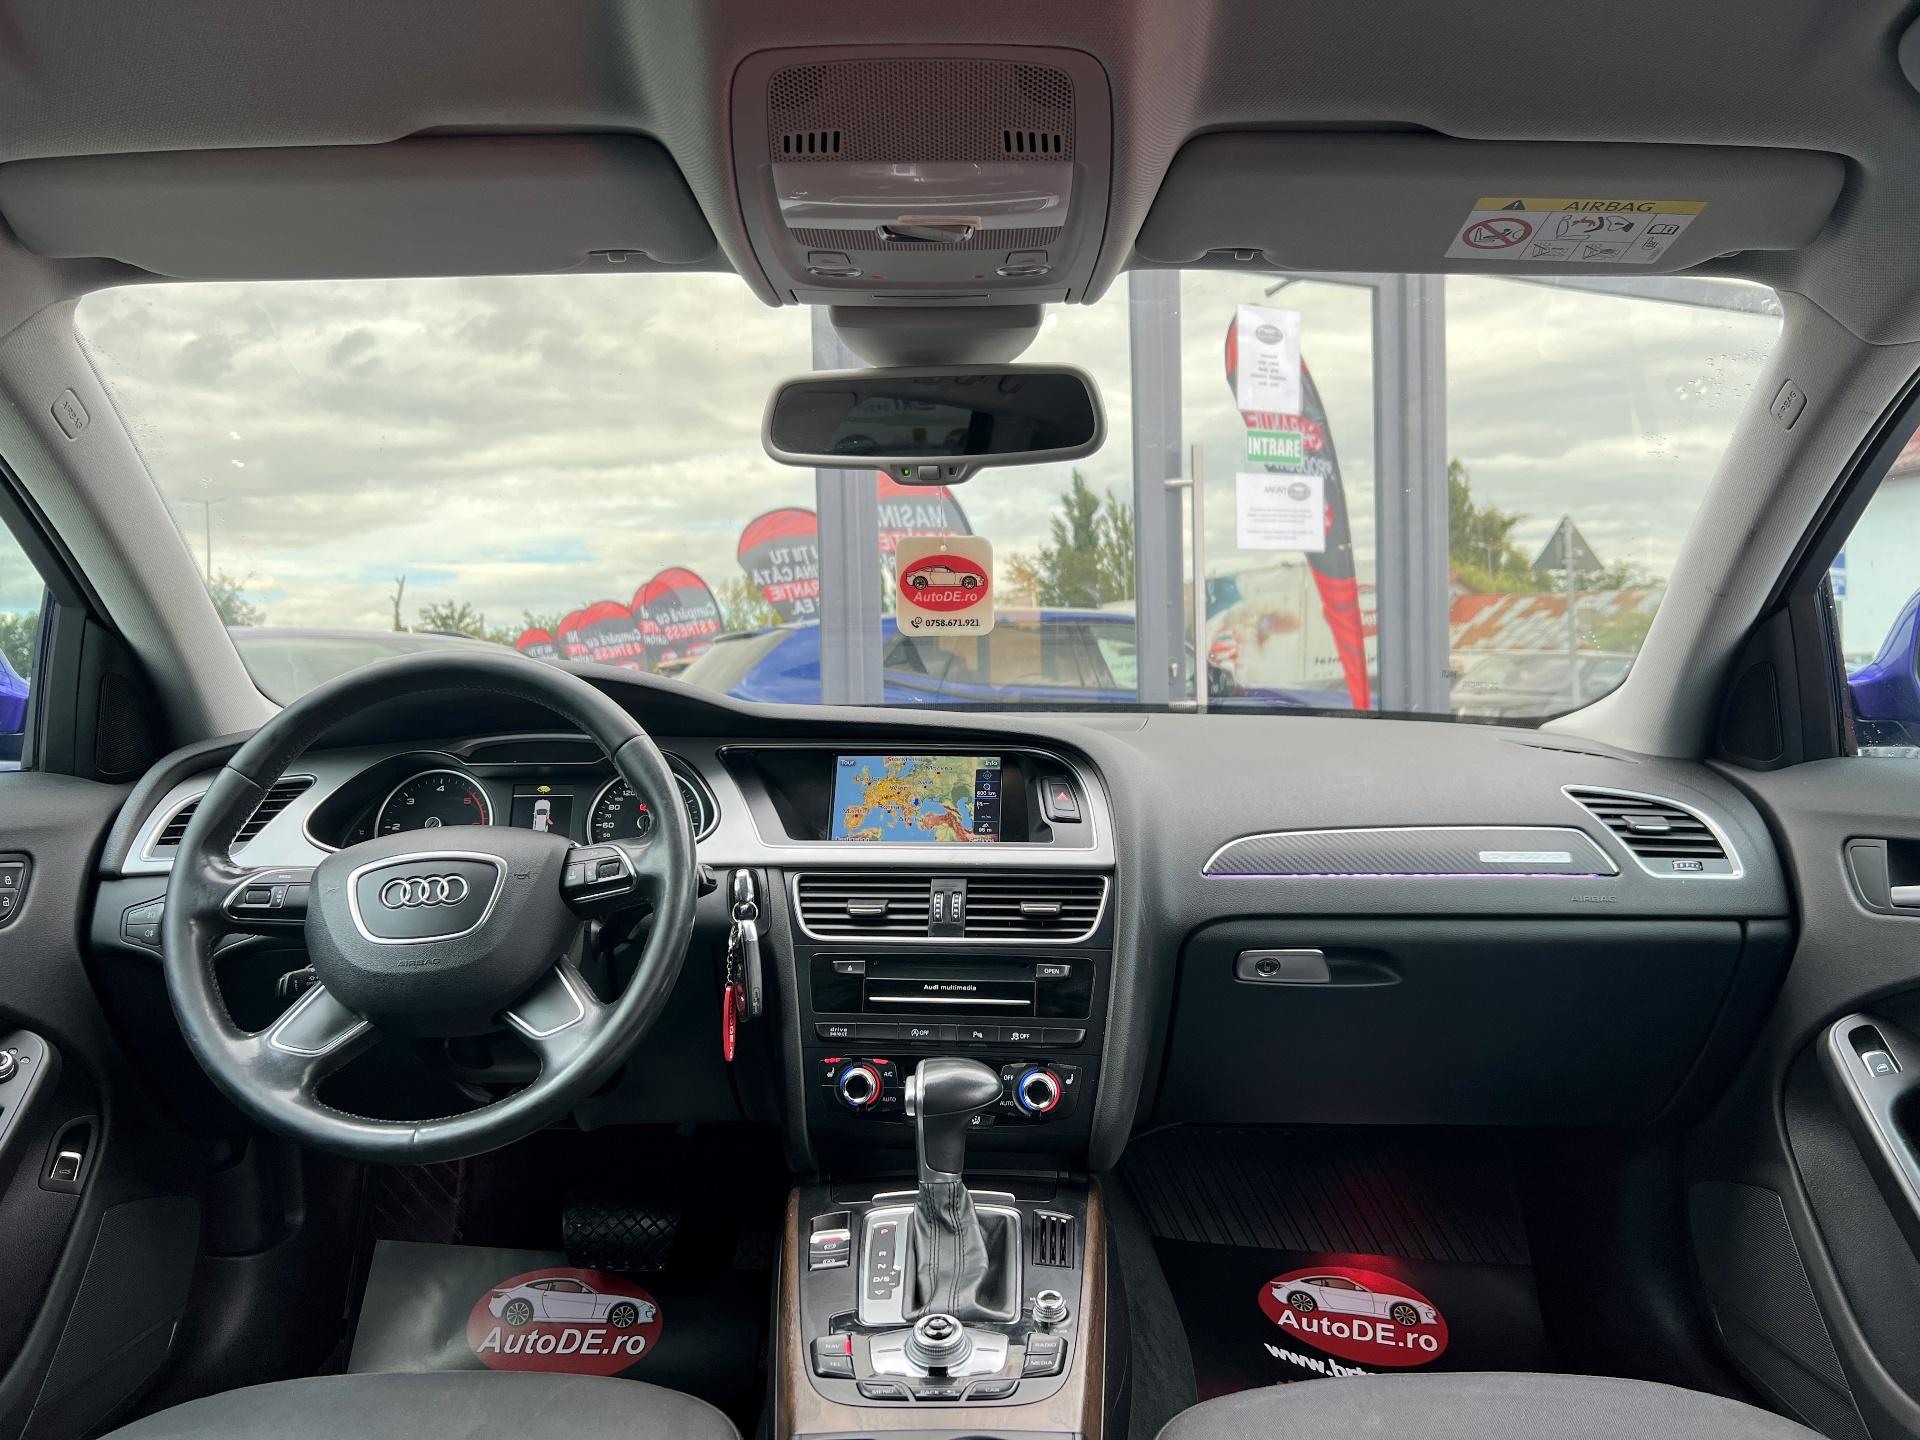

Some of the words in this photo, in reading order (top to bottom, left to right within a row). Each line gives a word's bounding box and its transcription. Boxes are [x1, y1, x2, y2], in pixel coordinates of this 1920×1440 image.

[1562, 201, 1656, 213] AIRBAG
[1248, 436, 1301, 457] INTRARE
[913, 591, 978, 603] AutoDE.ro
[925, 618, 980, 628] 0758.671.921
[463, 797, 472, 805] 5
[391, 823, 401, 831] 2
[396, 957, 442, 967] AIRBAG
[1277, 1309, 1439, 1352] AutoDE.ro
[476, 1327, 646, 1355] AutoDE.ro
